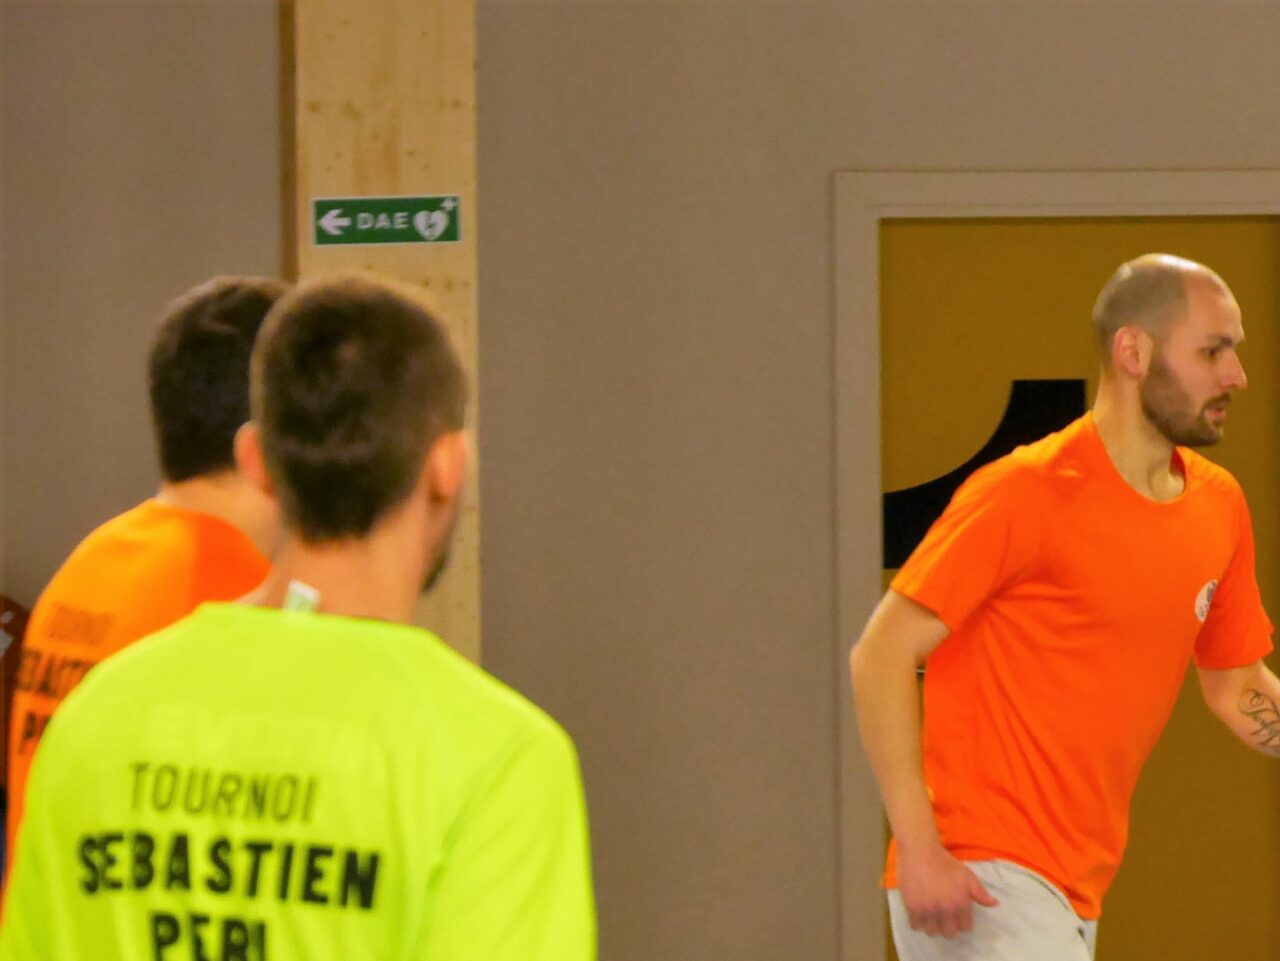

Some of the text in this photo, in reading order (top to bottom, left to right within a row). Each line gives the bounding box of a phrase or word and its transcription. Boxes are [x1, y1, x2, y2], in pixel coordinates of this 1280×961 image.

[357, 211, 409, 230] DAE
[130, 762, 319, 826] TOURNOI
[78, 831, 381, 910] SEBASTIEN
